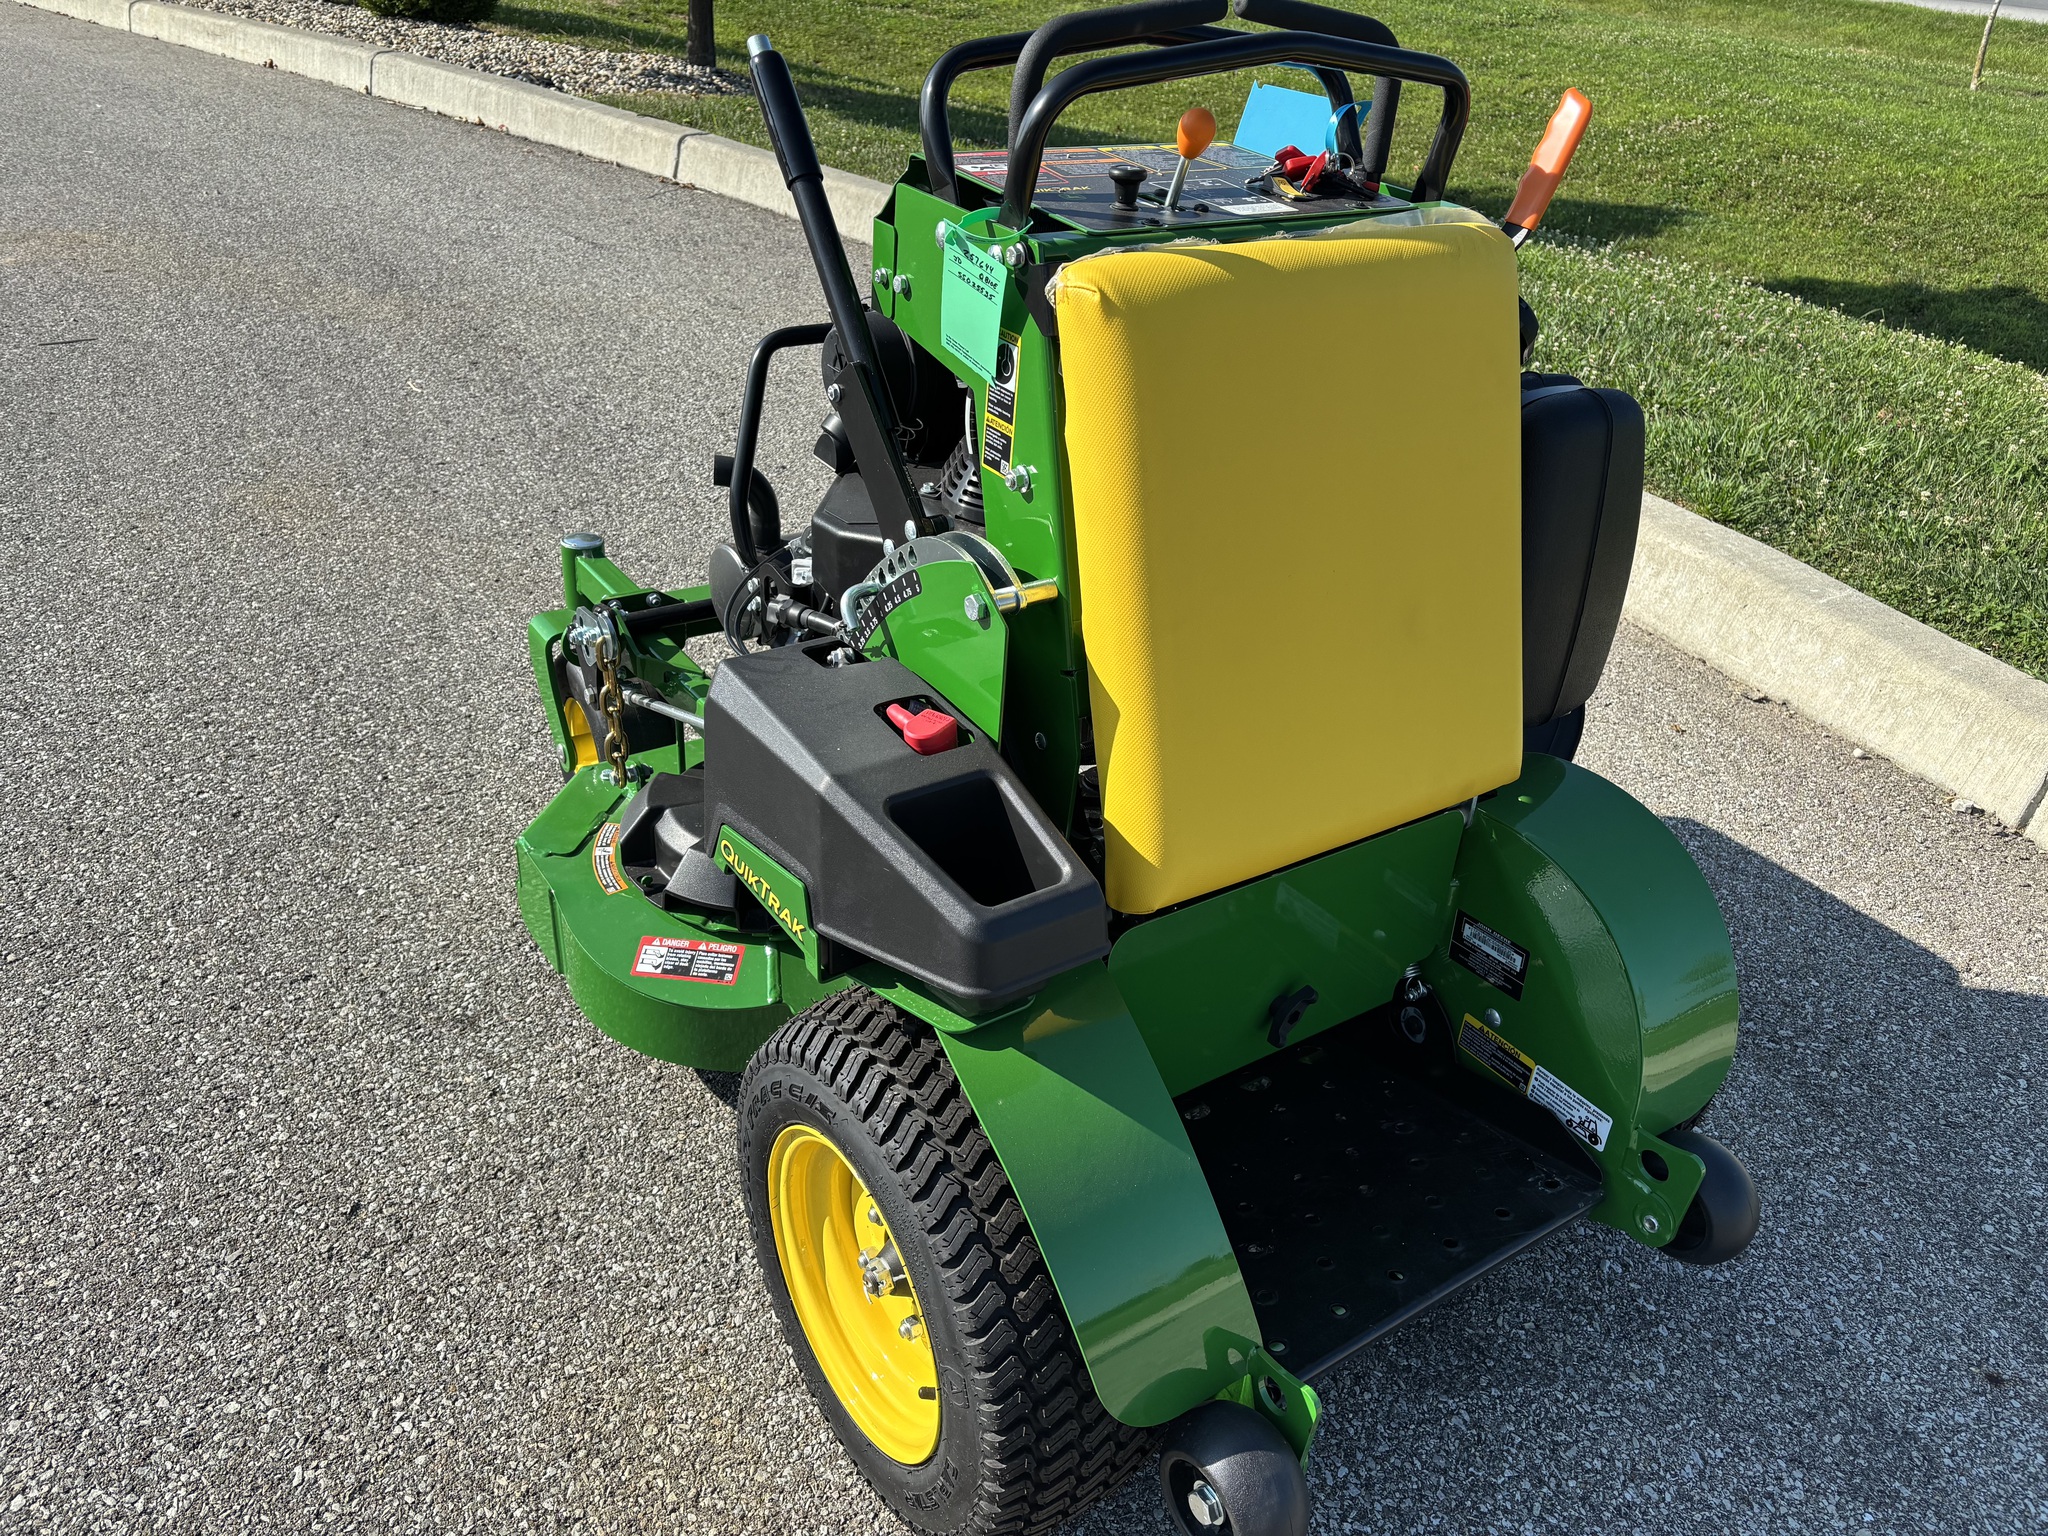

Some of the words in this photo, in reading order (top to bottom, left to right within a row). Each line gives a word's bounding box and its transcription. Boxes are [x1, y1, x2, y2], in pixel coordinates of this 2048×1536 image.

[720, 839, 807, 942] QUIKTRAK
[662, 938, 690, 947] DANGER
[708, 944, 737, 952] PELIGRO
[1485, 1028, 1521, 1059] ATENCIÓN
